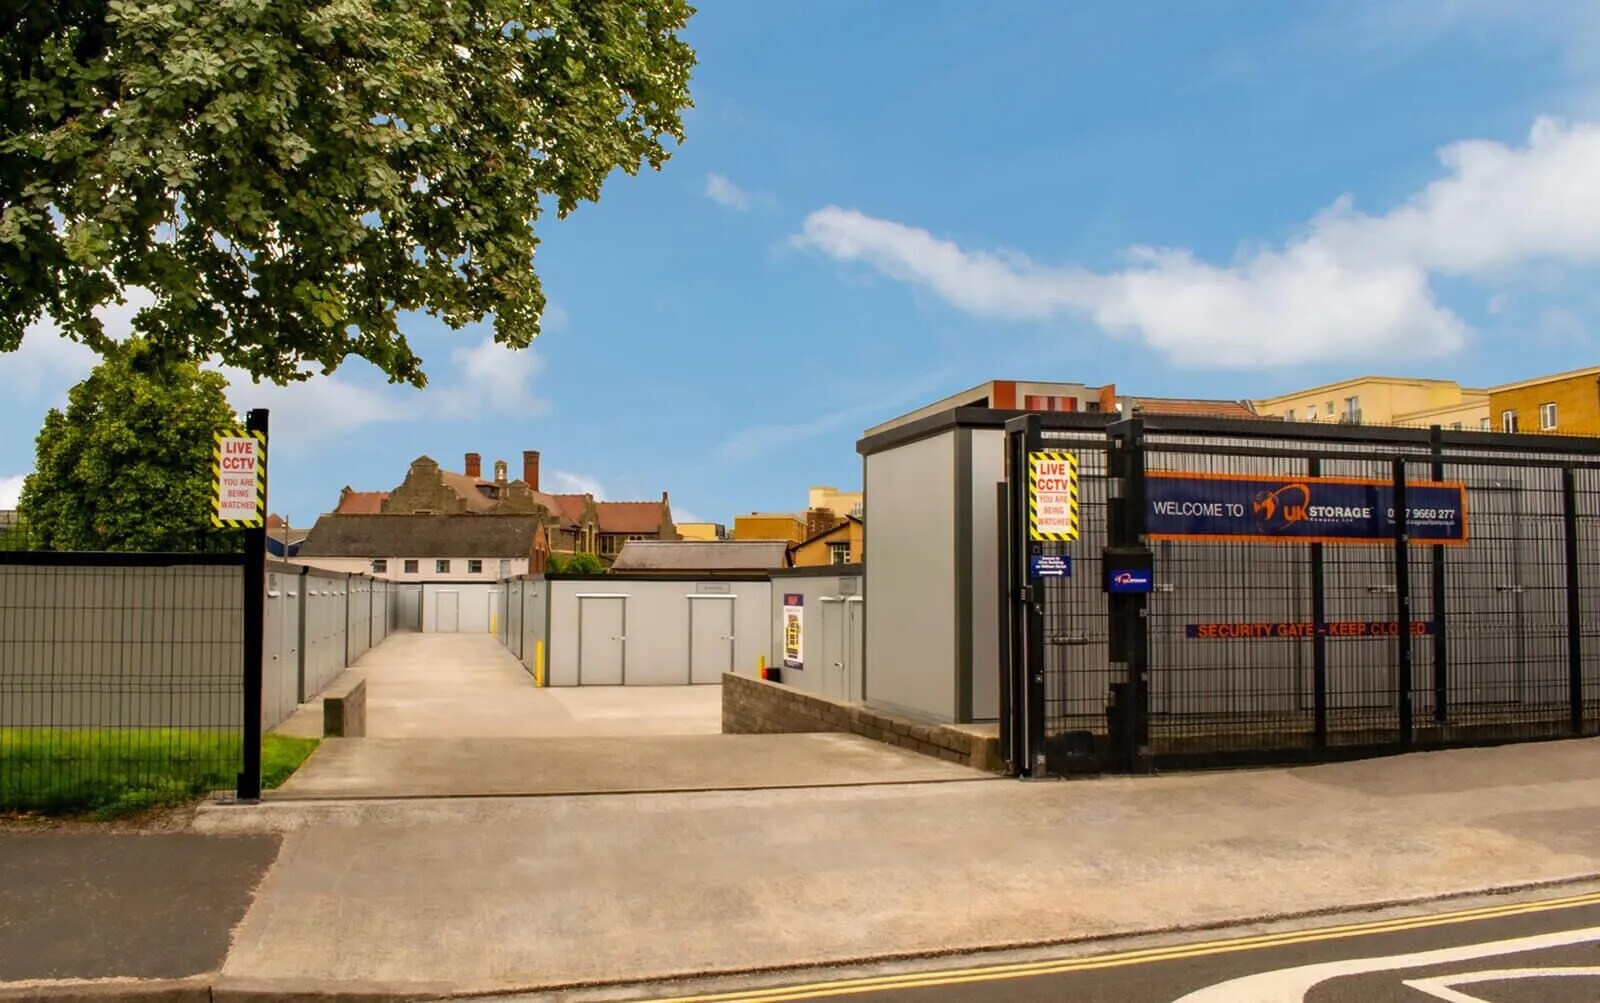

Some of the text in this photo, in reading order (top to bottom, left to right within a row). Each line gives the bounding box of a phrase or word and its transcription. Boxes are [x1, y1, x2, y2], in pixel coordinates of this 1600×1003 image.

[226, 442, 253, 454] LIVE
[223, 457, 255, 469] CCTV
[1040, 463, 1065, 475] LIVE
[223, 478, 238, 486] YOU
[1037, 479, 1068, 490] CCTV
[221, 501, 256, 509] WATCHED
[1039, 495, 1068, 504] YOU ARE
[1043, 506, 1064, 514] BEING
[1153, 501, 1244, 517] WELCOME TO
[1283, 505, 1371, 520] UK STORAGE
[1438, 509, 1455, 519] 277
[1038, 517, 1071, 526] WATCHED
[1199, 624, 1272, 637] SECURITY
[1278, 623, 1314, 636] GATE
[1329, 622, 1366, 635] KEEP
[1370, 622, 1426, 635] CLOED
